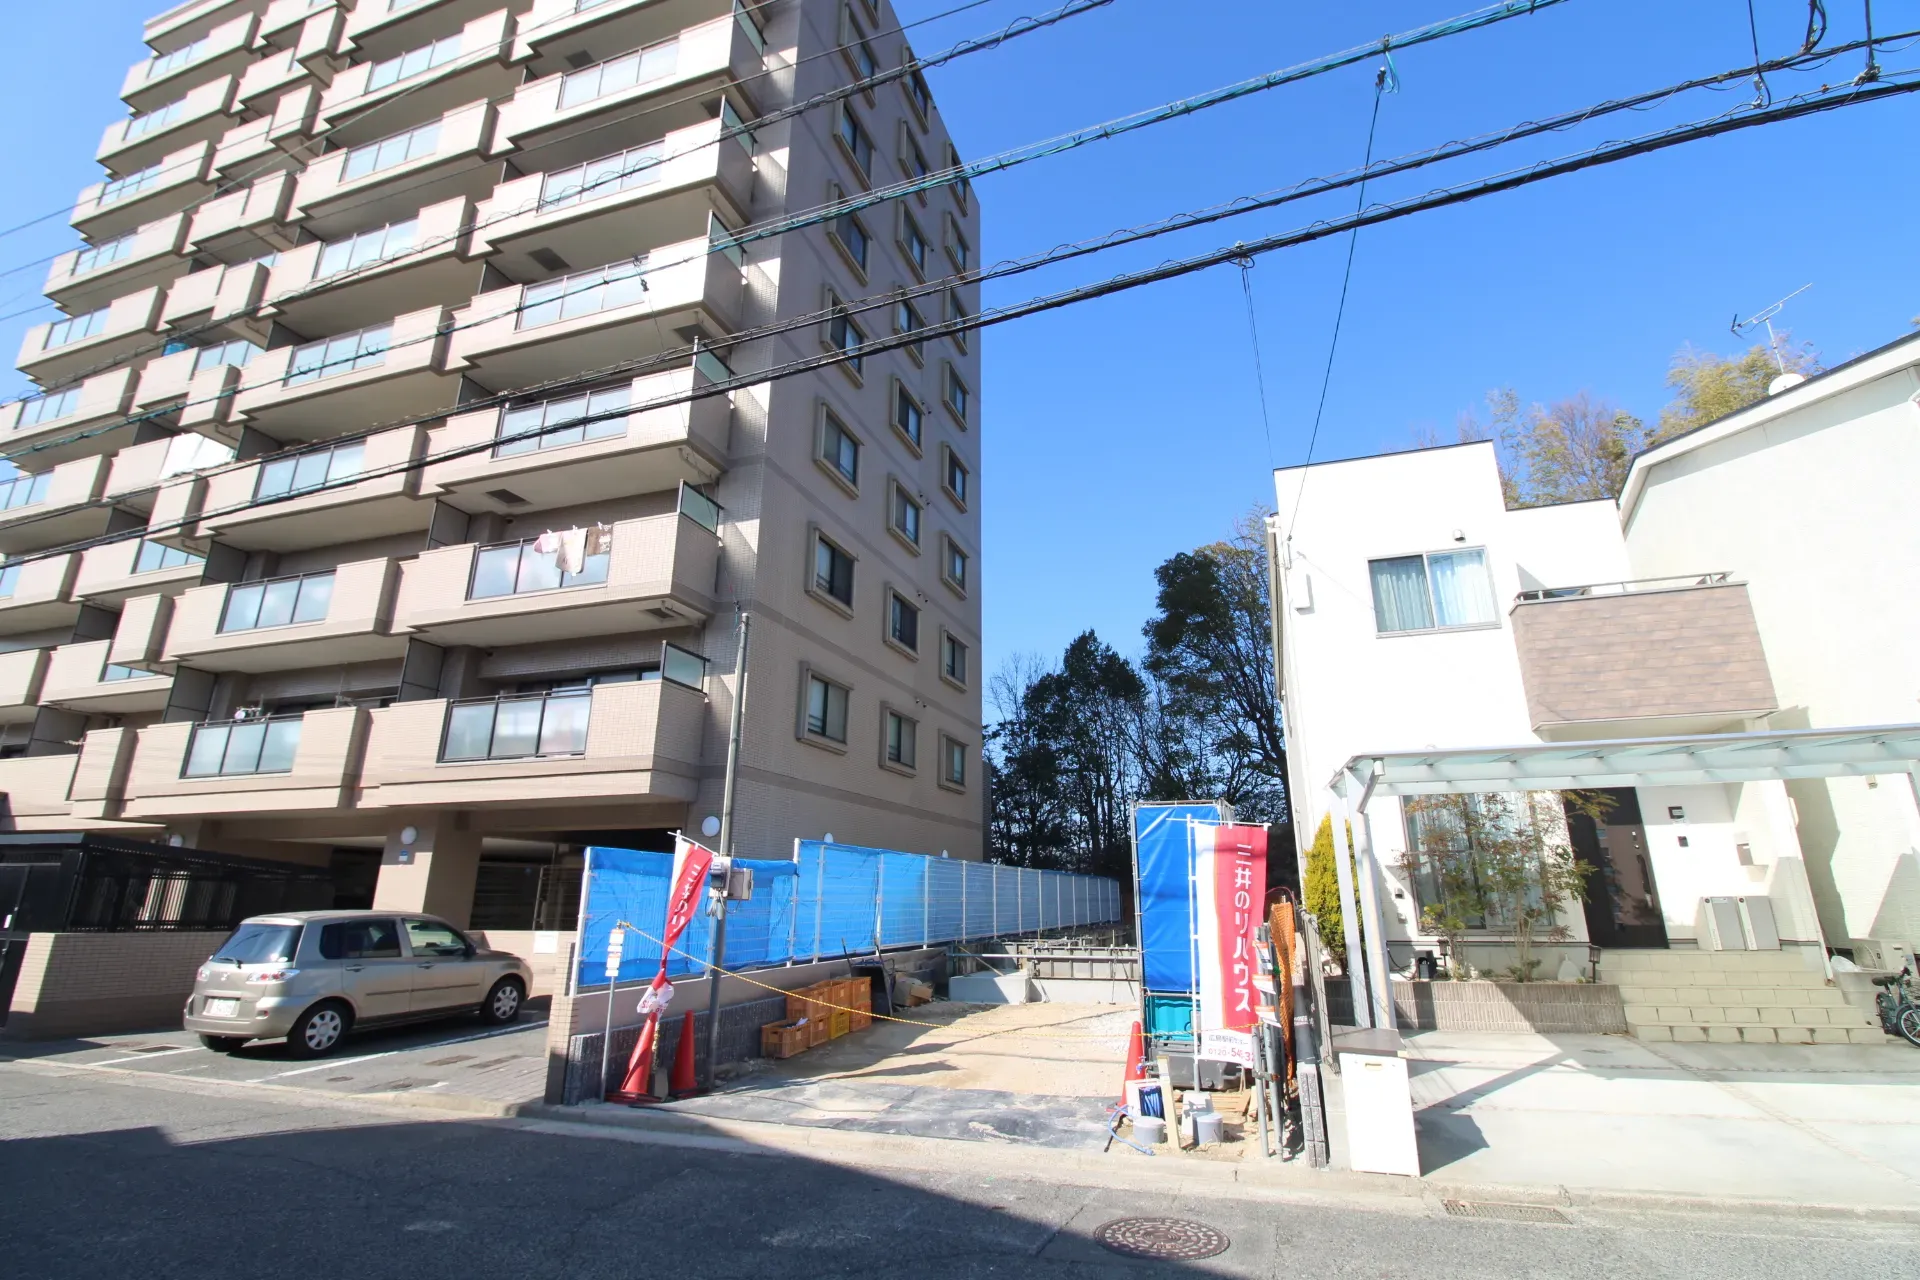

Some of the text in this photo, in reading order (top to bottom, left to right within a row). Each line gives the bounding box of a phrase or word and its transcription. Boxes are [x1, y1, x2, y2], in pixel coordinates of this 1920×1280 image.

[1233, 843, 1252, 1012] 三井のリハウス
